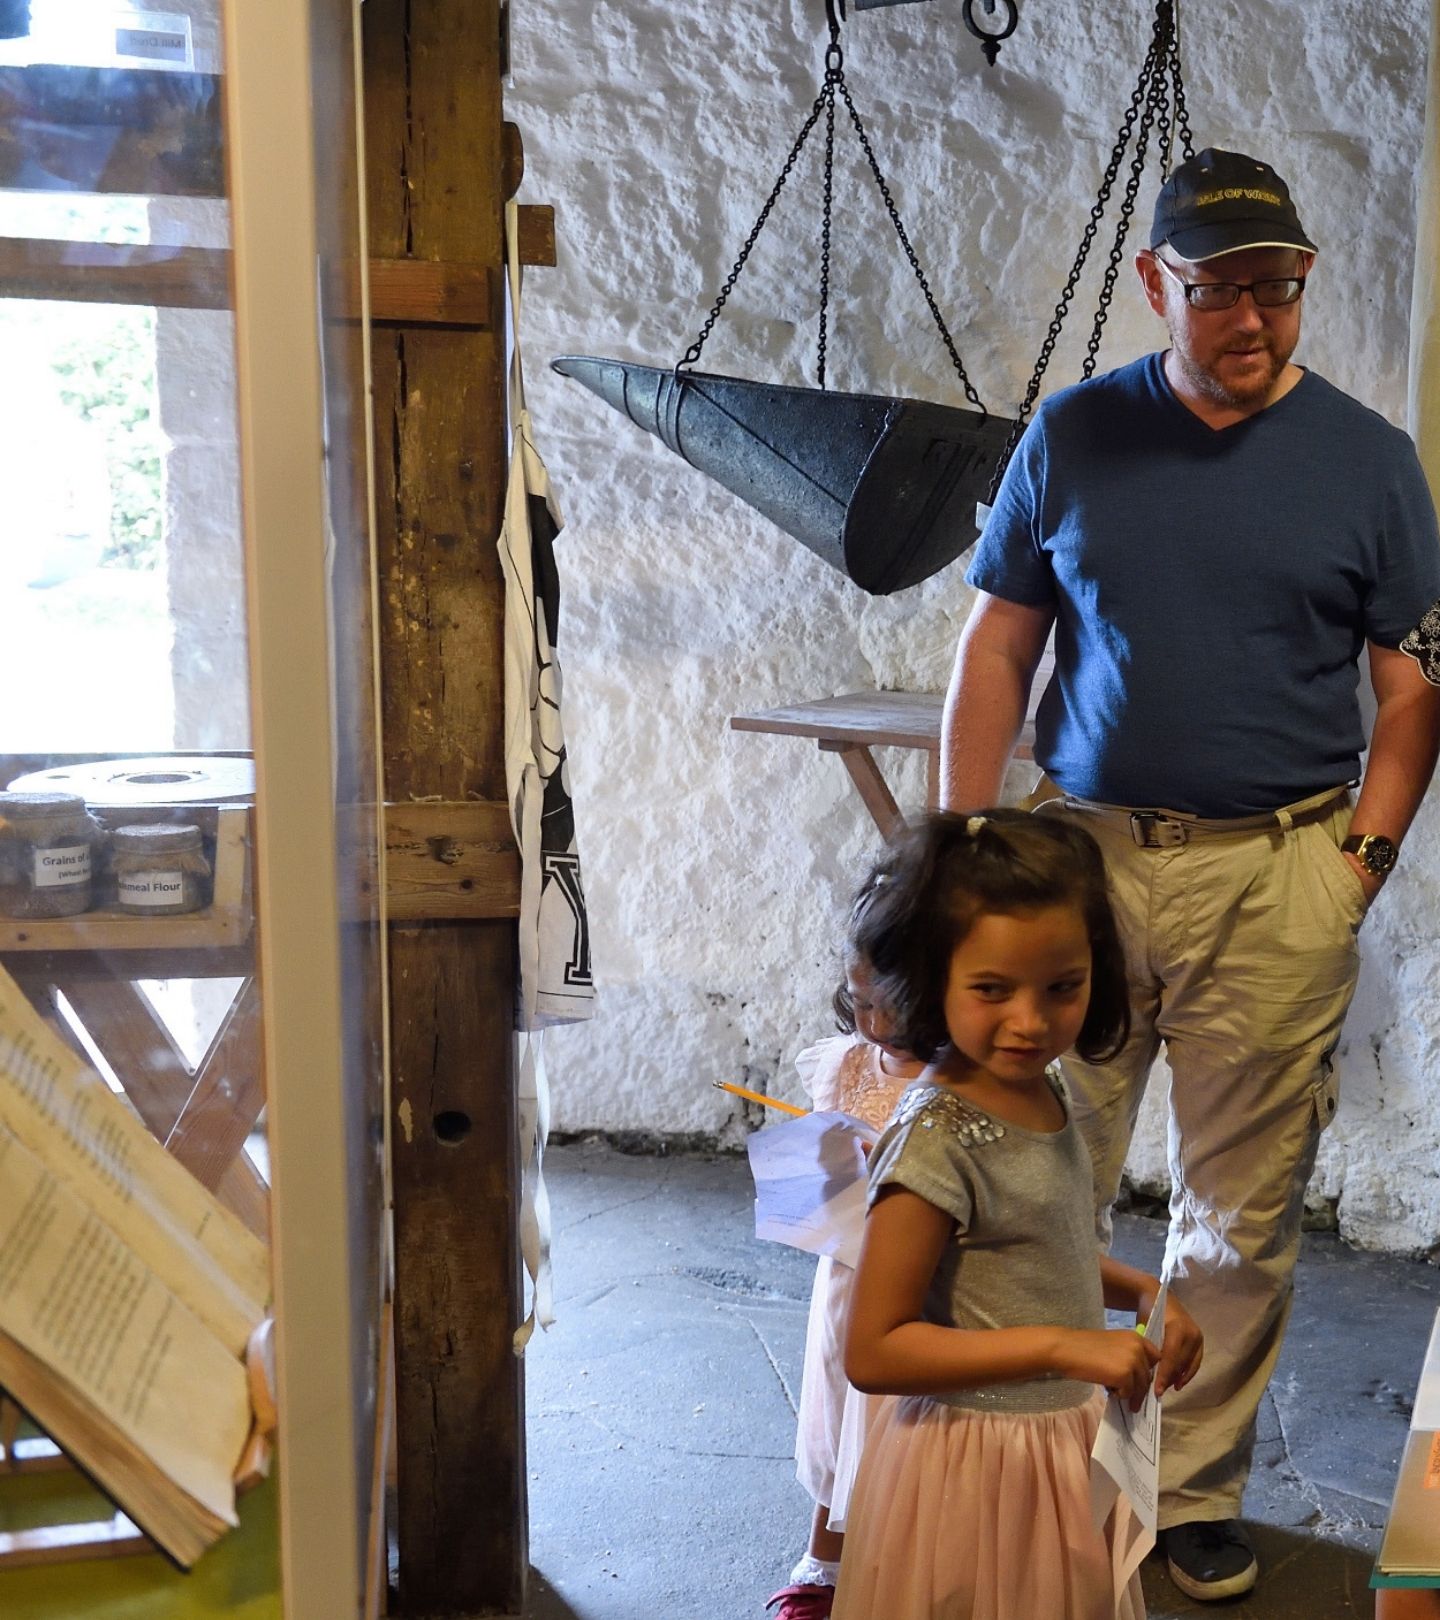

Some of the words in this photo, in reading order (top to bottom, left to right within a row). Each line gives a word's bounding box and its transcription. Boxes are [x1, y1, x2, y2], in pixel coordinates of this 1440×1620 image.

[1224, 188, 1242, 198] OF
[42, 856, 76, 866] Grains
[153, 882, 181, 892] Flour
